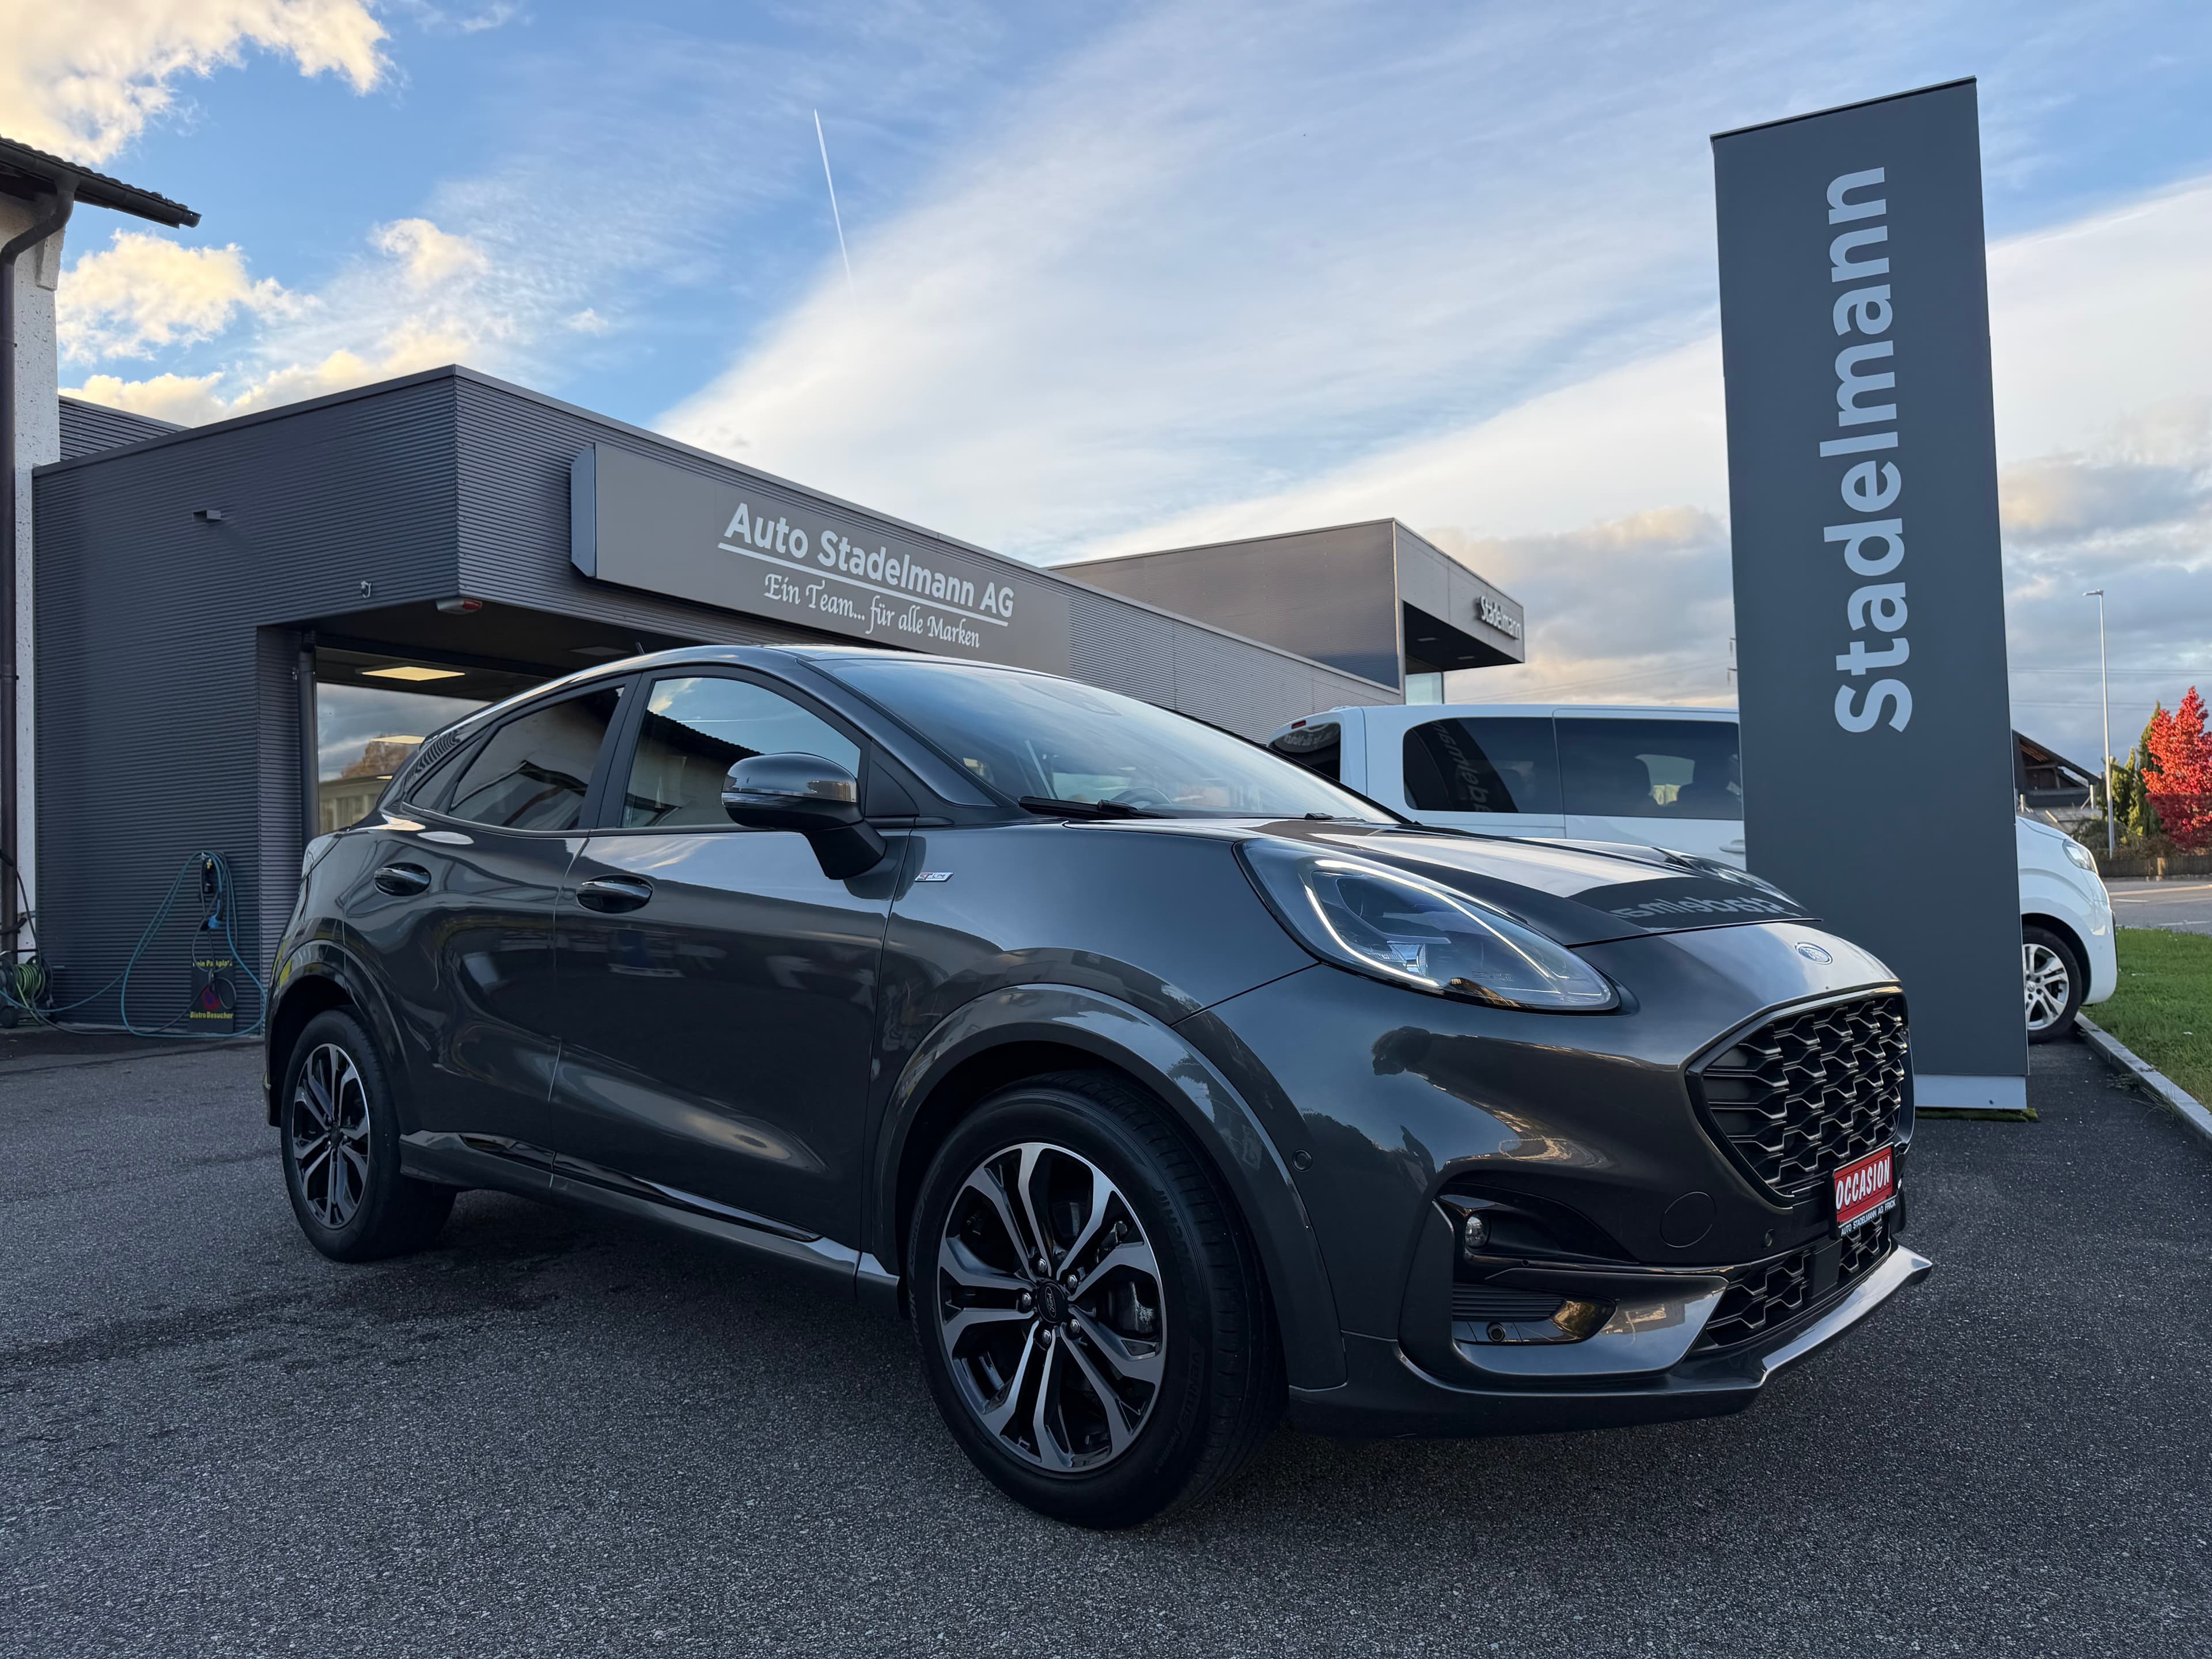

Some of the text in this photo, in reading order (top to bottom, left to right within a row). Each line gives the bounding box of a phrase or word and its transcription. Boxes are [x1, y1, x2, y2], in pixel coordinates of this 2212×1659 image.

[1819, 166, 1913, 733] Stadelmann
[724, 502, 1014, 618] Auto Stadelmann AG
[763, 573, 980, 648] Ein Team... für alle Marken
[1836, 1156, 1891, 1210] OCCASION
[1841, 1199, 1896, 1237] AUTO STADELMANN AG FRICK
